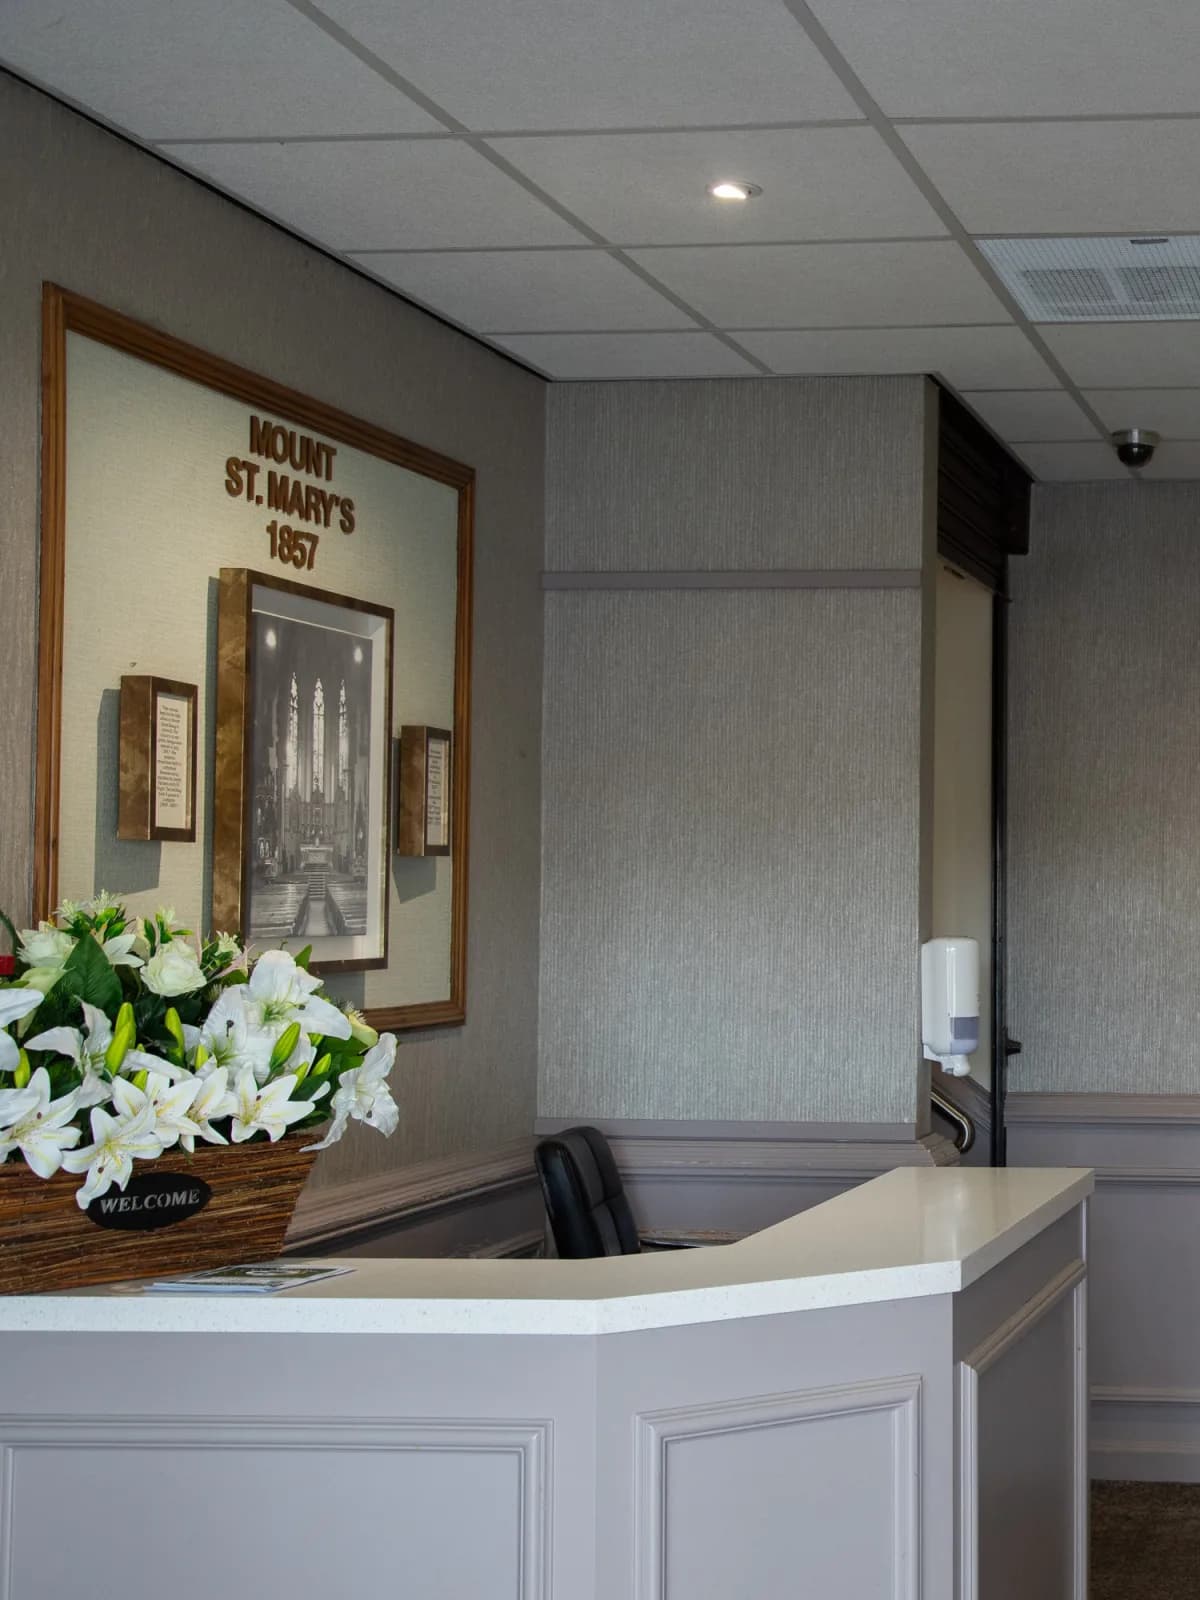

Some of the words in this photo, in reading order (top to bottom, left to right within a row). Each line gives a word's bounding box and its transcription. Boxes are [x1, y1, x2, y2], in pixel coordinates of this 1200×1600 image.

[249, 415, 337, 481] MOUNT
[225, 456, 264, 506] ST.
[267, 469, 356, 536] MARY'S
[266, 519, 320, 571] 1857
[101, 1189, 200, 1215] WELCOME
